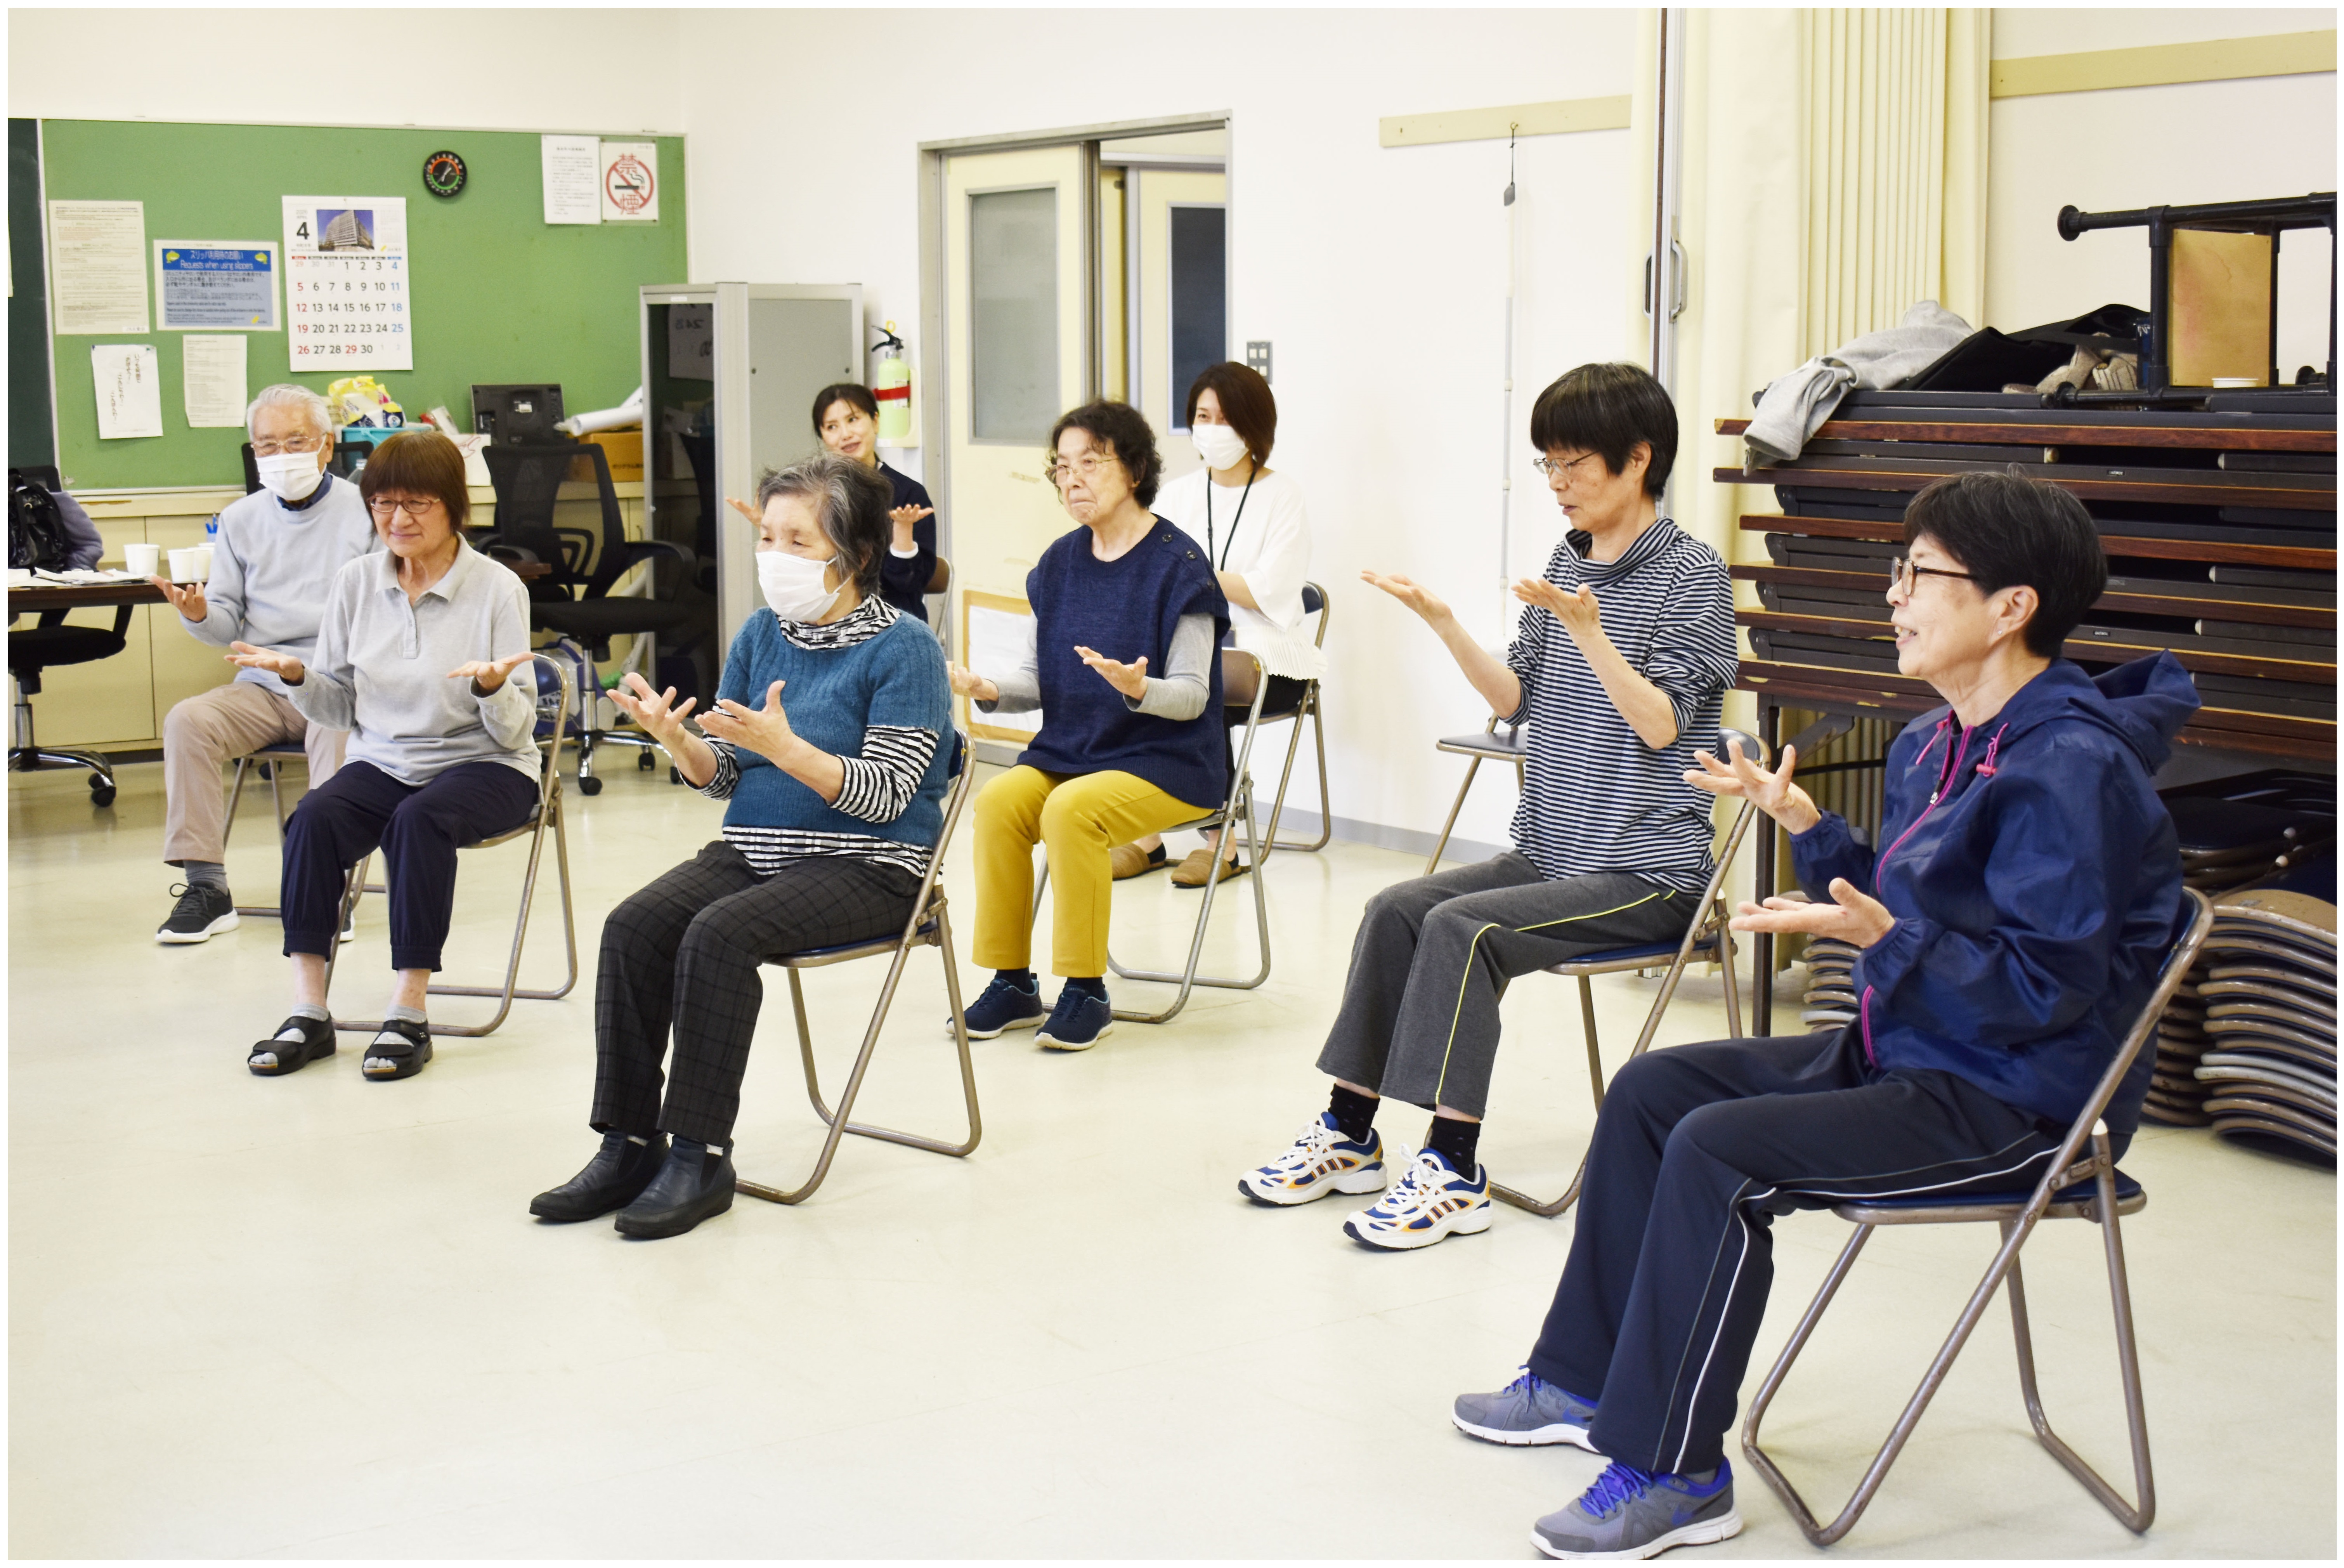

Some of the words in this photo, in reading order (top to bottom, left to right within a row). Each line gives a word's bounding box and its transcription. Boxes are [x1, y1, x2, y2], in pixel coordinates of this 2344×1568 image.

[619, 153, 638, 174] 禁
[620, 194, 640, 215] 煙
[296, 222, 310, 240] 4
[180, 260, 204, 269] Requests
[235, 261, 253, 270] slippers
[360, 261, 366, 270] 2
[376, 262, 382, 270] 3
[298, 282, 303, 291] 5
[313, 282, 319, 291] 6
[345, 282, 351, 291] 8
[361, 282, 367, 291] 9
[375, 282, 385, 291] 10
[296, 304, 307, 312] 12
[313, 303, 323, 312] 13
[345, 303, 355, 312] 15
[360, 303, 370, 312] 16
[392, 303, 402, 311] 18
[298, 324, 308, 333] 19
[313, 324, 324, 333] 20
[329, 324, 338, 333] 21
[344, 324, 356, 333] 22
[360, 324, 372, 333] 23
[376, 324, 387, 332] 24
[392, 324, 403, 332] 25
[298, 346, 310, 354] 26
[314, 345, 325, 354] 27
[329, 345, 341, 354] 28
[345, 345, 357, 354] 29
[361, 345, 373, 354] 30
